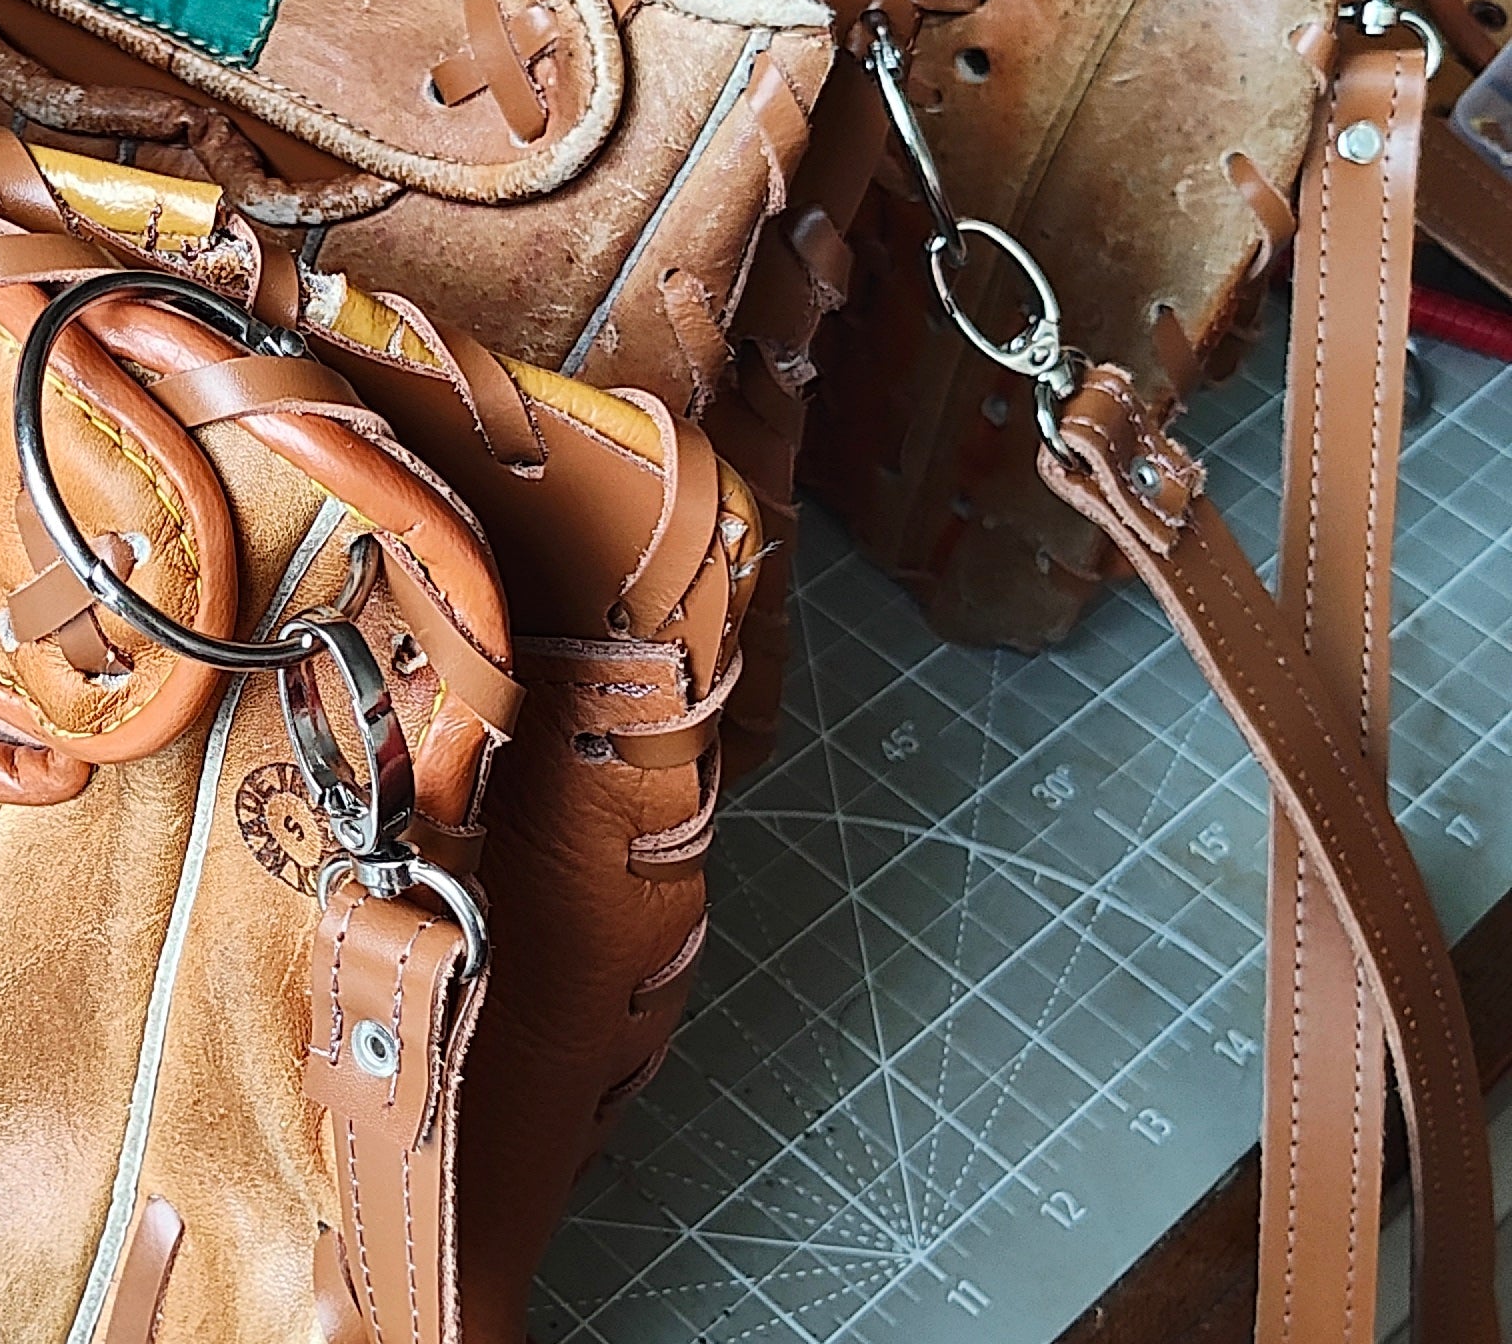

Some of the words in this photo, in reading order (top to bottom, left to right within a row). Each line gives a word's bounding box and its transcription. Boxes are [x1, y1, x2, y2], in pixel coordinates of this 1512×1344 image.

[882, 719, 920, 764] 45°
[1031, 764, 1078, 811] 30°
[1189, 822, 1231, 866] 15°
[1214, 1028, 1259, 1067] 14
[1129, 1106, 1176, 1147] 13
[1040, 1190, 1087, 1230] 12
[946, 1277, 991, 1318] 11
